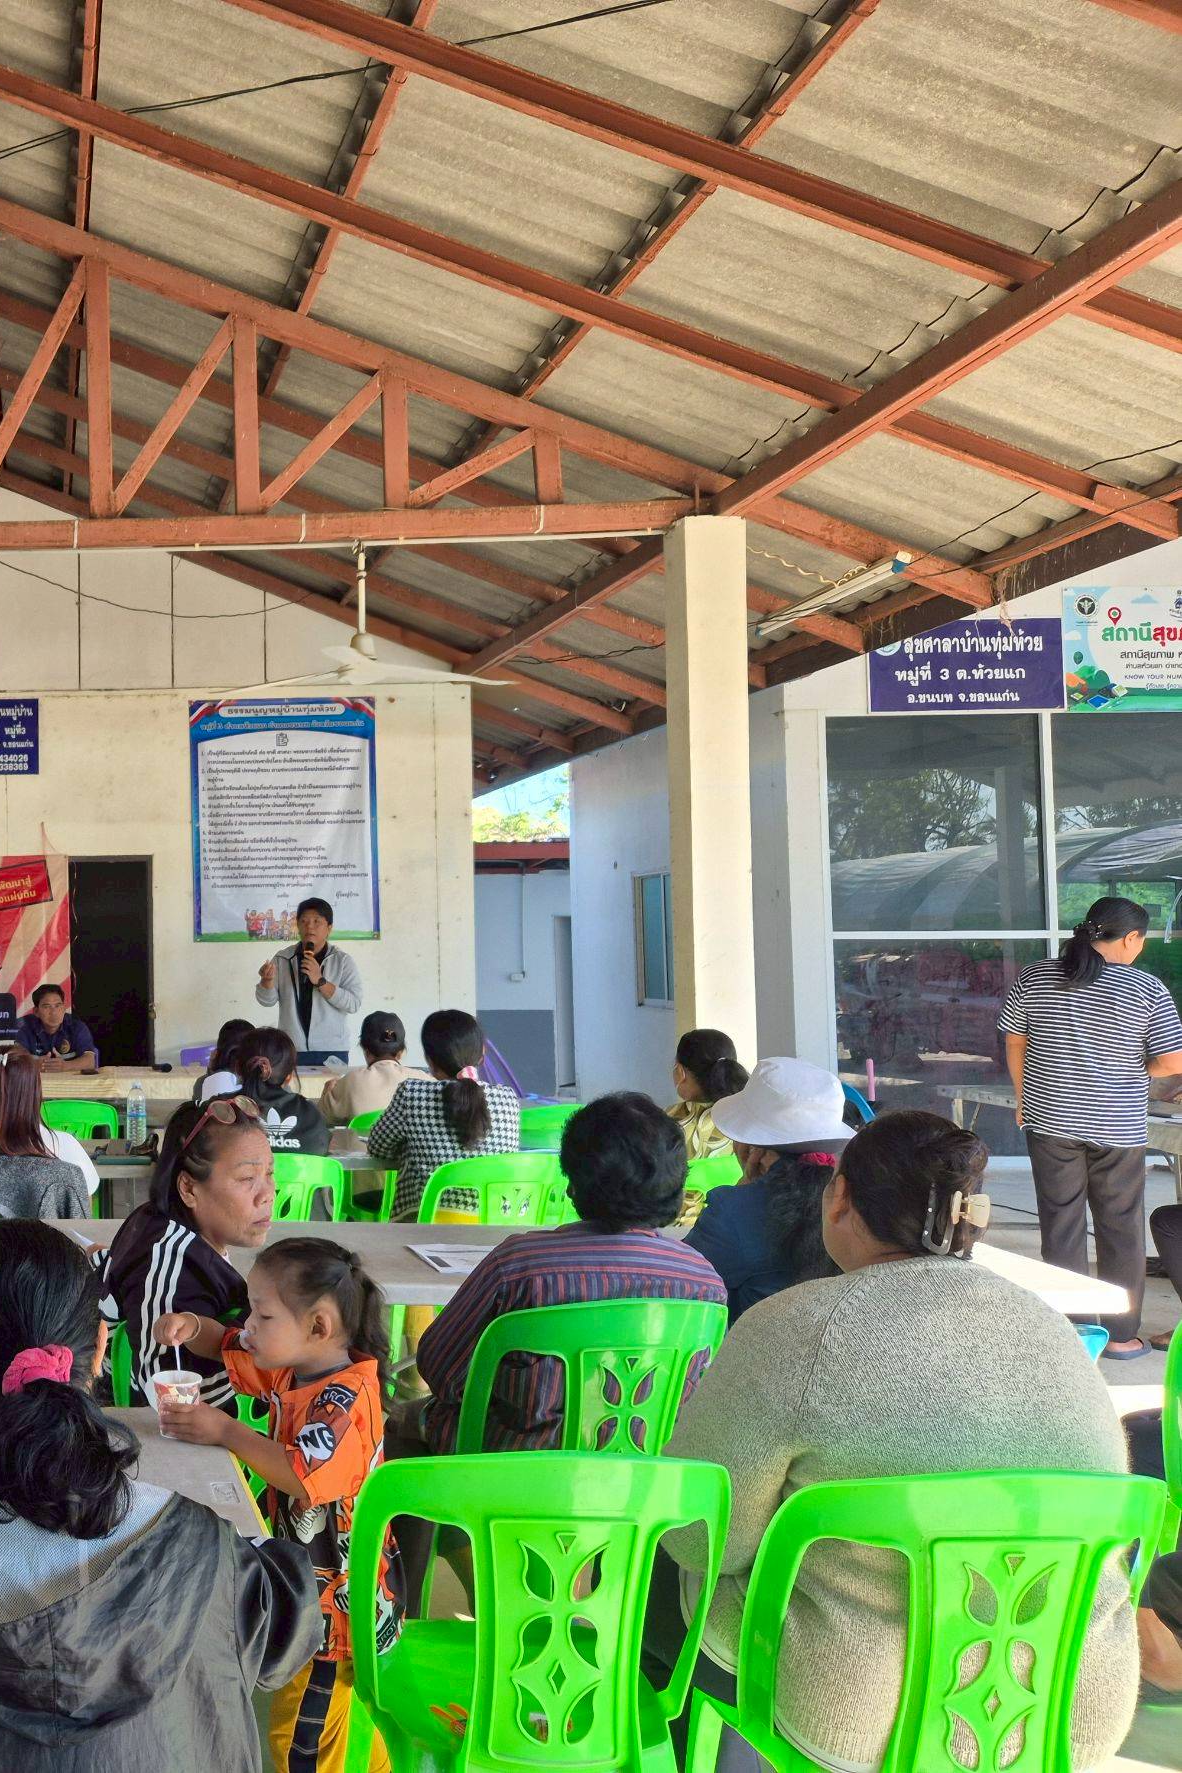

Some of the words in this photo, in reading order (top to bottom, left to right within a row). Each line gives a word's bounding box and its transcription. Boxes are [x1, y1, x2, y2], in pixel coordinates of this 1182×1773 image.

[895, 662, 931, 686] หมู่ที่
[940, 668, 950, 680] 3
[956, 664, 1026, 680] ต.ห้วยแก
[907, 693, 953, 704] อ.ชนบท
[958, 689, 1020, 704] จ.ขอนแก่น
[266, 1136, 301, 1148] didas
[296, 1426, 335, 1452] NG
